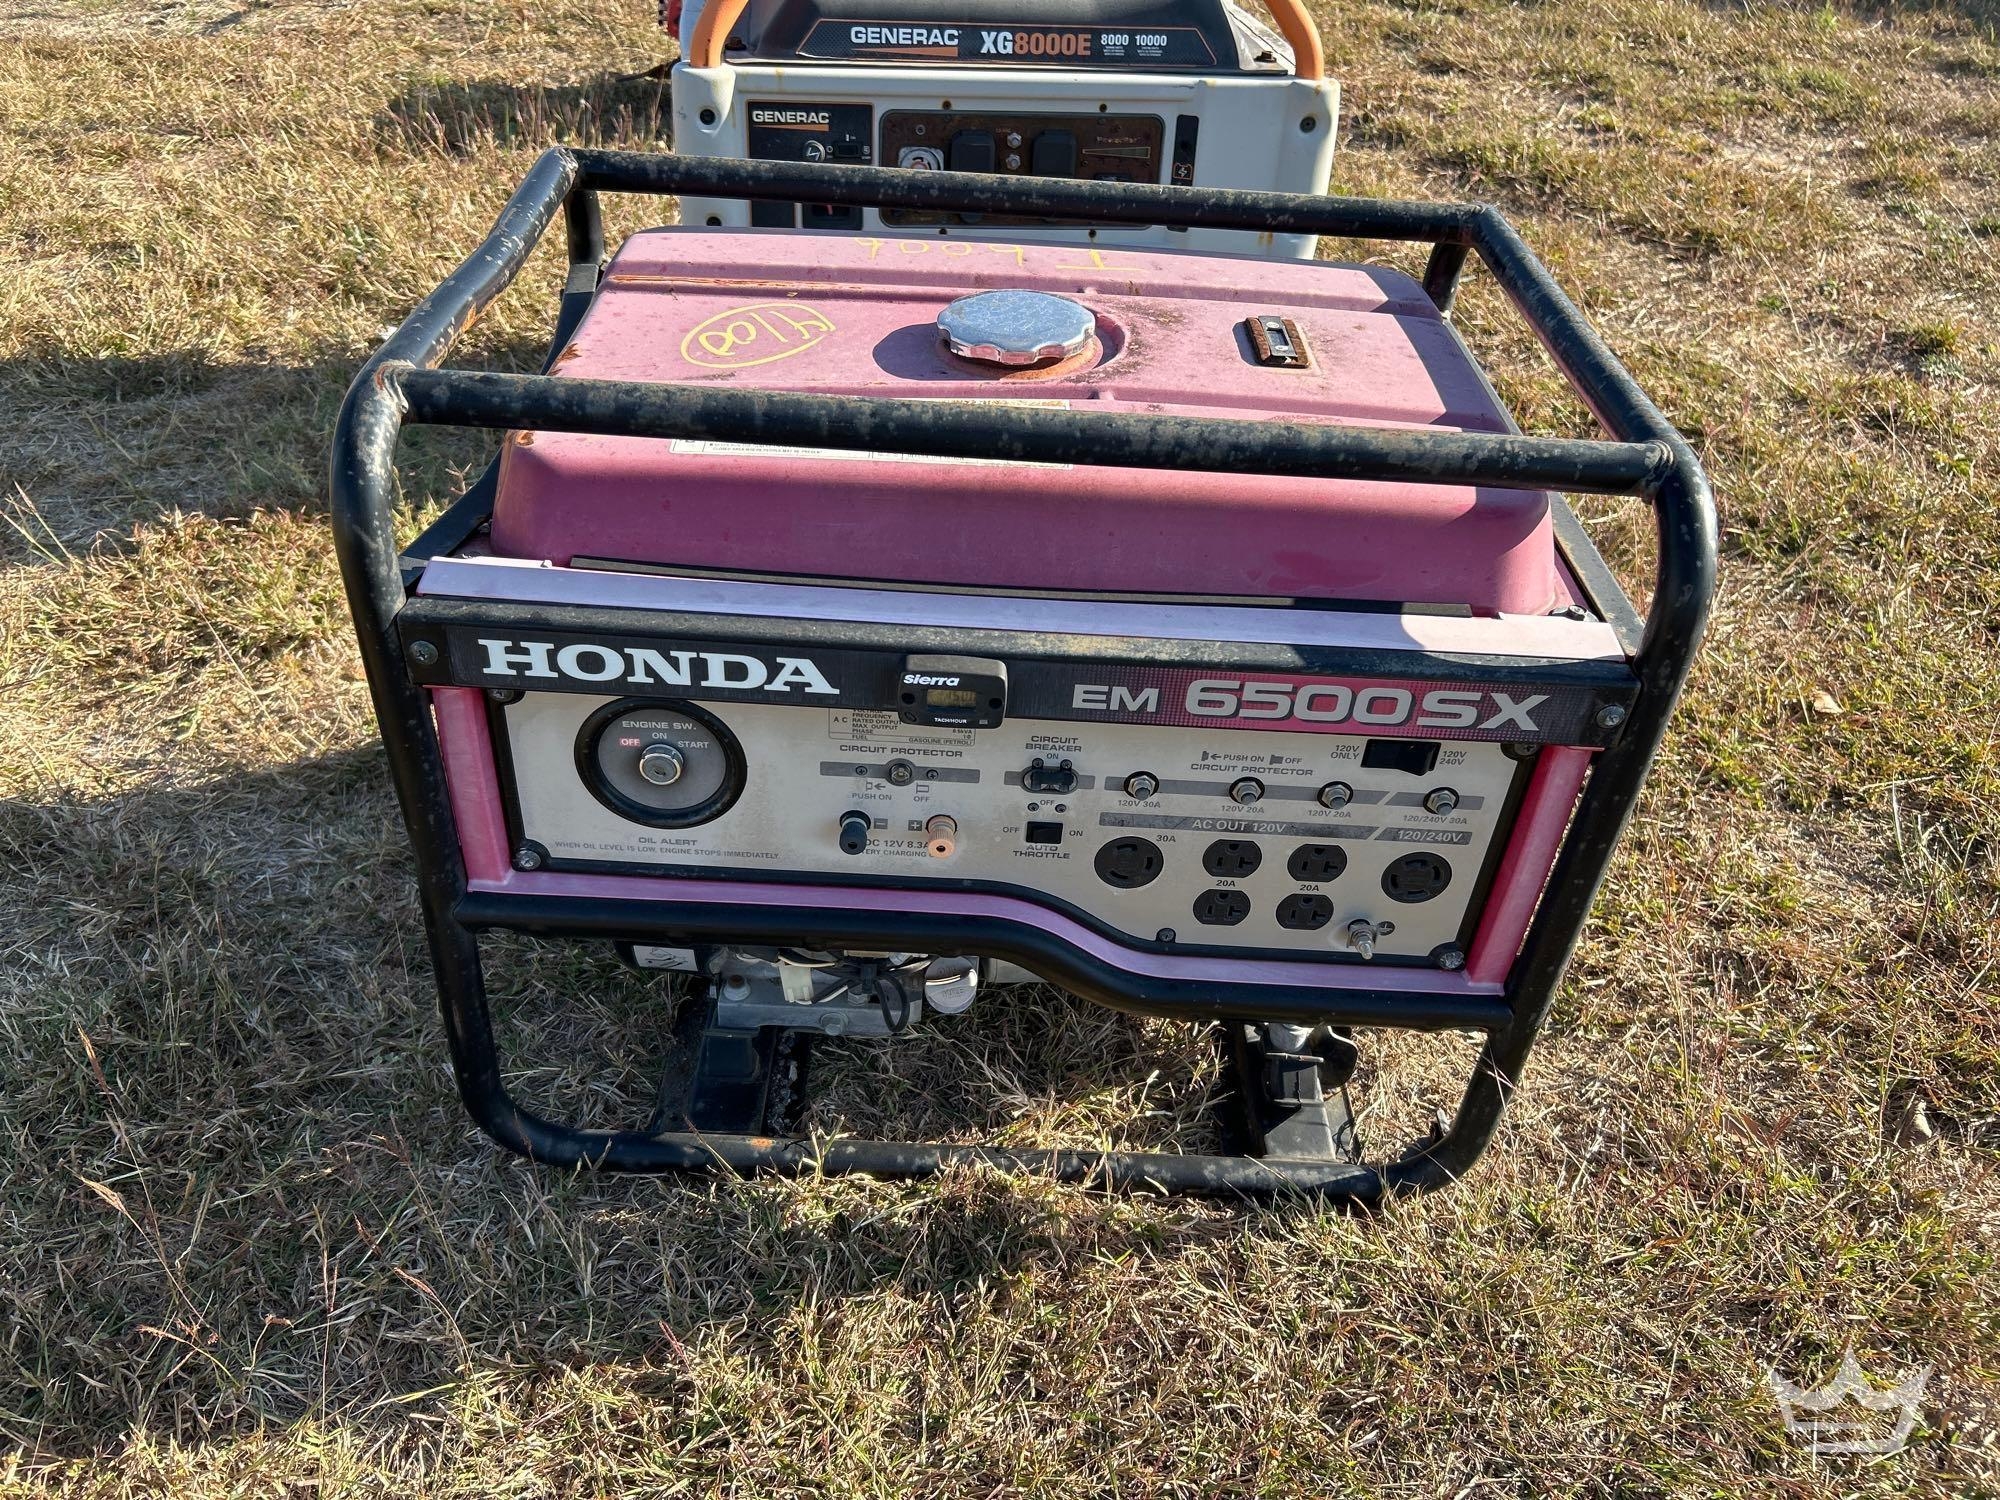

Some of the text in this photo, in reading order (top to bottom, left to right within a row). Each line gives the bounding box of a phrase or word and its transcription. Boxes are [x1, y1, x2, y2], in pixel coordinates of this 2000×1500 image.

[850, 26, 960, 46] GENERAC
[980, 31, 1091, 56] XG8000E
[1100, 34, 1167, 47] 8000 10000
[752, 110, 830, 124] GENERAC
[477, 638, 840, 695] HONDA
[903, 674, 960, 687] sierra
[1072, 679, 1550, 732] EM 6500SX
[852, 712, 892, 720] FREQUENCY
[622, 720, 697, 730] ENGINE SW.
[621, 738, 640, 746] OFF
[908, 737, 942, 745] GASOLINE
[1031, 735, 1079, 744] CIRCUIT
[677, 740, 709, 749] START
[1025, 743, 1082, 752] BREAKER
[1335, 744, 1360, 752] 120V
[839, 744, 963, 758] CIRCUIT PROTECTOR
[1330, 751, 1360, 760] ONLY
[1443, 750, 1467, 758] 120V
[1223, 753, 1303, 765] PUSH ON OFF
[1439, 757, 1466, 766] 240V
[1190, 763, 1314, 776] CIRCUIT PROTECTOR
[1118, 799, 1161, 808] 120V 30A
[1221, 805, 1265, 814] 120V 20A
[1307, 809, 1352, 818] 120V 20A
[1402, 814, 1467, 825] 120/240V 30A
[1191, 819, 1287, 833] AC OUT 120V
[1156, 834, 1176, 843] 30A
[1397, 830, 1463, 843] 120/240V
[638, 837, 699, 846] OIL ALERT
[884, 840, 904, 848] 12V
[555, 841, 581, 849] WHEN
[599, 843, 624, 851] LEVEL
[659, 846, 692, 855] ENGINE
[694, 848, 721, 856] STOPS
[1012, 850, 1071, 859] THROTTLE
[1216, 879, 1236, 888] 20A
[1300, 884, 1320, 892] 20A
